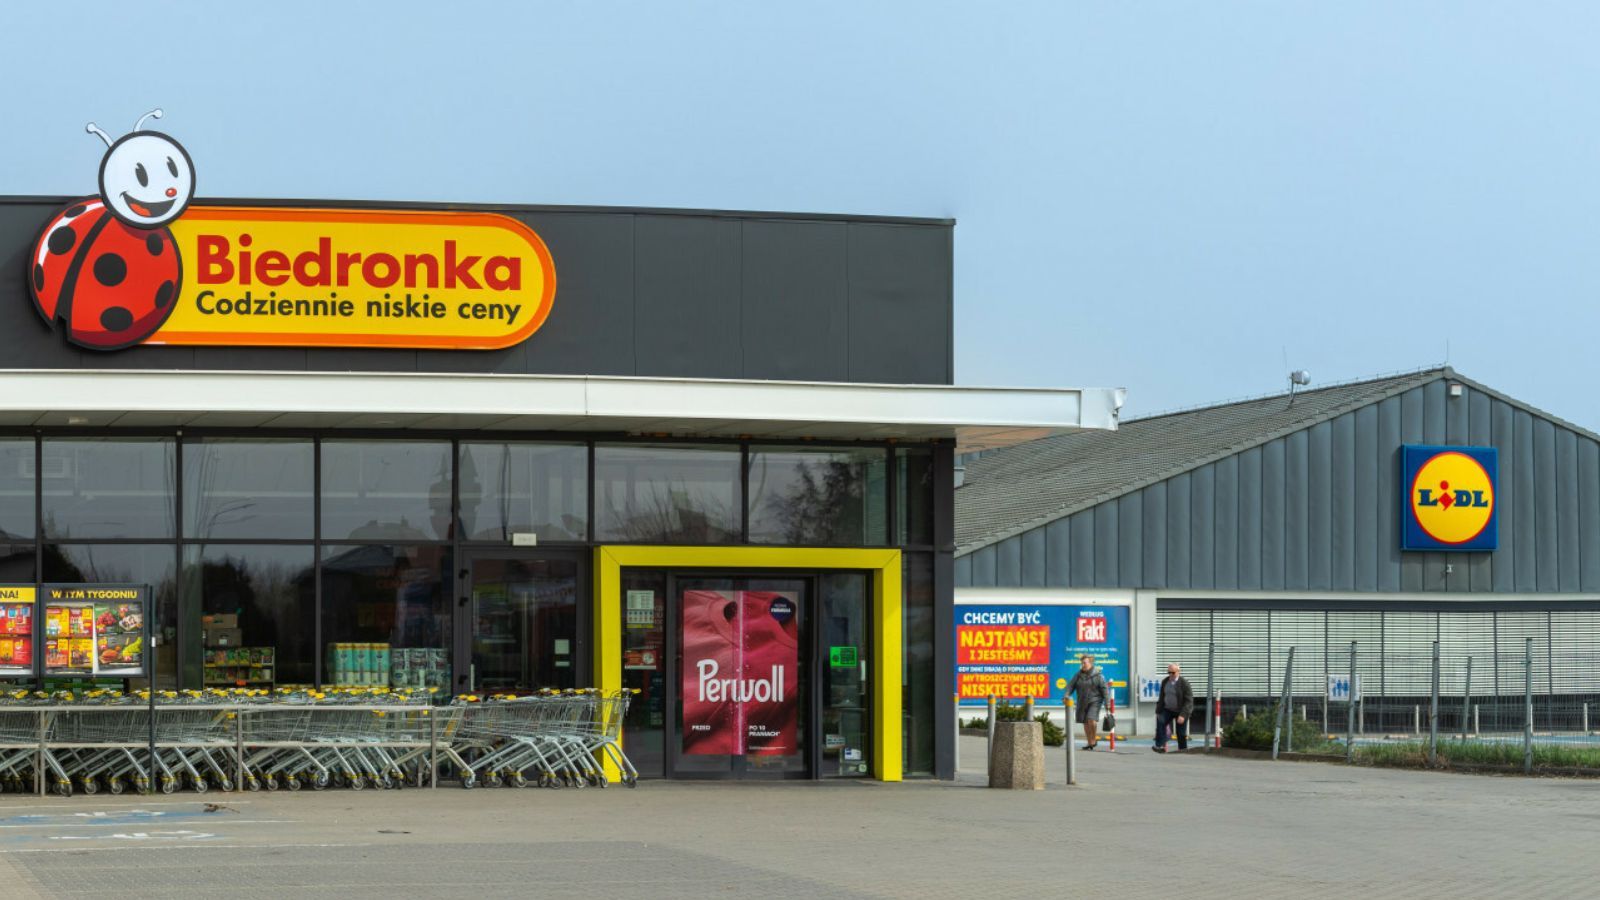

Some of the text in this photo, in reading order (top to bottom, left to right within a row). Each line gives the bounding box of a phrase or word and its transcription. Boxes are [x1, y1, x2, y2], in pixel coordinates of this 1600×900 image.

[196, 233, 522, 291] Biedronka
[196, 290, 522, 325] Codziennie niskie ceny
[51, 590, 62, 599] W
[87, 590, 138, 599] TYGODNIU
[963, 609, 1041, 624] CHCEMY BYĆ
[960, 628, 1047, 647] NAJTAŃSI
[1078, 619, 1105, 641] Fakt
[970, 648, 1034, 661] I JESTEŚMY
[696, 658, 785, 703] Perwoll
[963, 674, 1045, 683] MY TROSZCZYMY SIĘ O
[962, 684, 1009, 697] NISKIE
[1011, 684, 1046, 697] CENY
